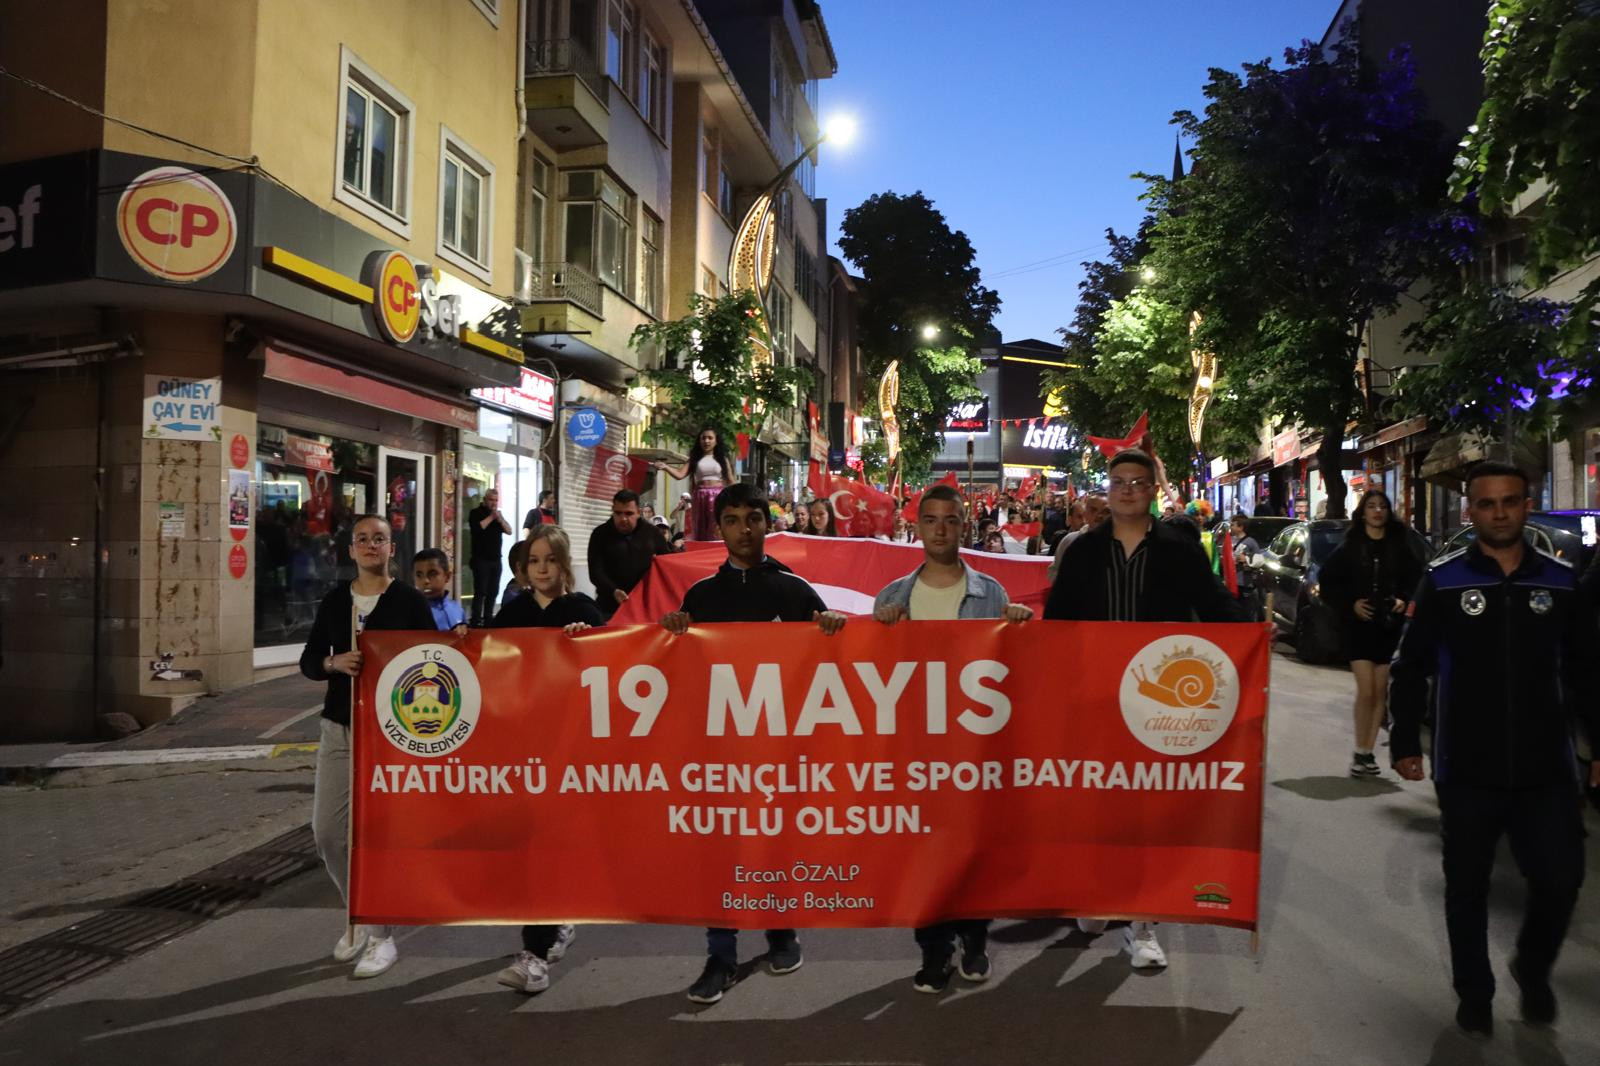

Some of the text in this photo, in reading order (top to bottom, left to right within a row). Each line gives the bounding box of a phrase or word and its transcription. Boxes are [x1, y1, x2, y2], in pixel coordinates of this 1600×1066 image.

[136, 198, 219, 248] CP
[387, 275, 415, 315] CP
[158, 378, 212, 400] GÜNEY
[153, 401, 214, 421] ÇAY EVİ
[422, 649, 445, 662] T.C.
[580, 660, 1013, 738] 19 MAYIS
[1144, 711, 1217, 732] cittaslow
[384, 718, 471, 754] VİZE BELEDİYESİ
[1162, 733, 1197, 747] vize
[371, 755, 1246, 802] ATATÜRK'Ü ANMA GENÇLİK VE SPOR BAYRAMIMIZ
[669, 804, 932, 836] KUTLU OLSUN.
[736, 861, 861, 883] Ercan ÖZALP
[722, 891, 875, 912] Belediye Başkanı
